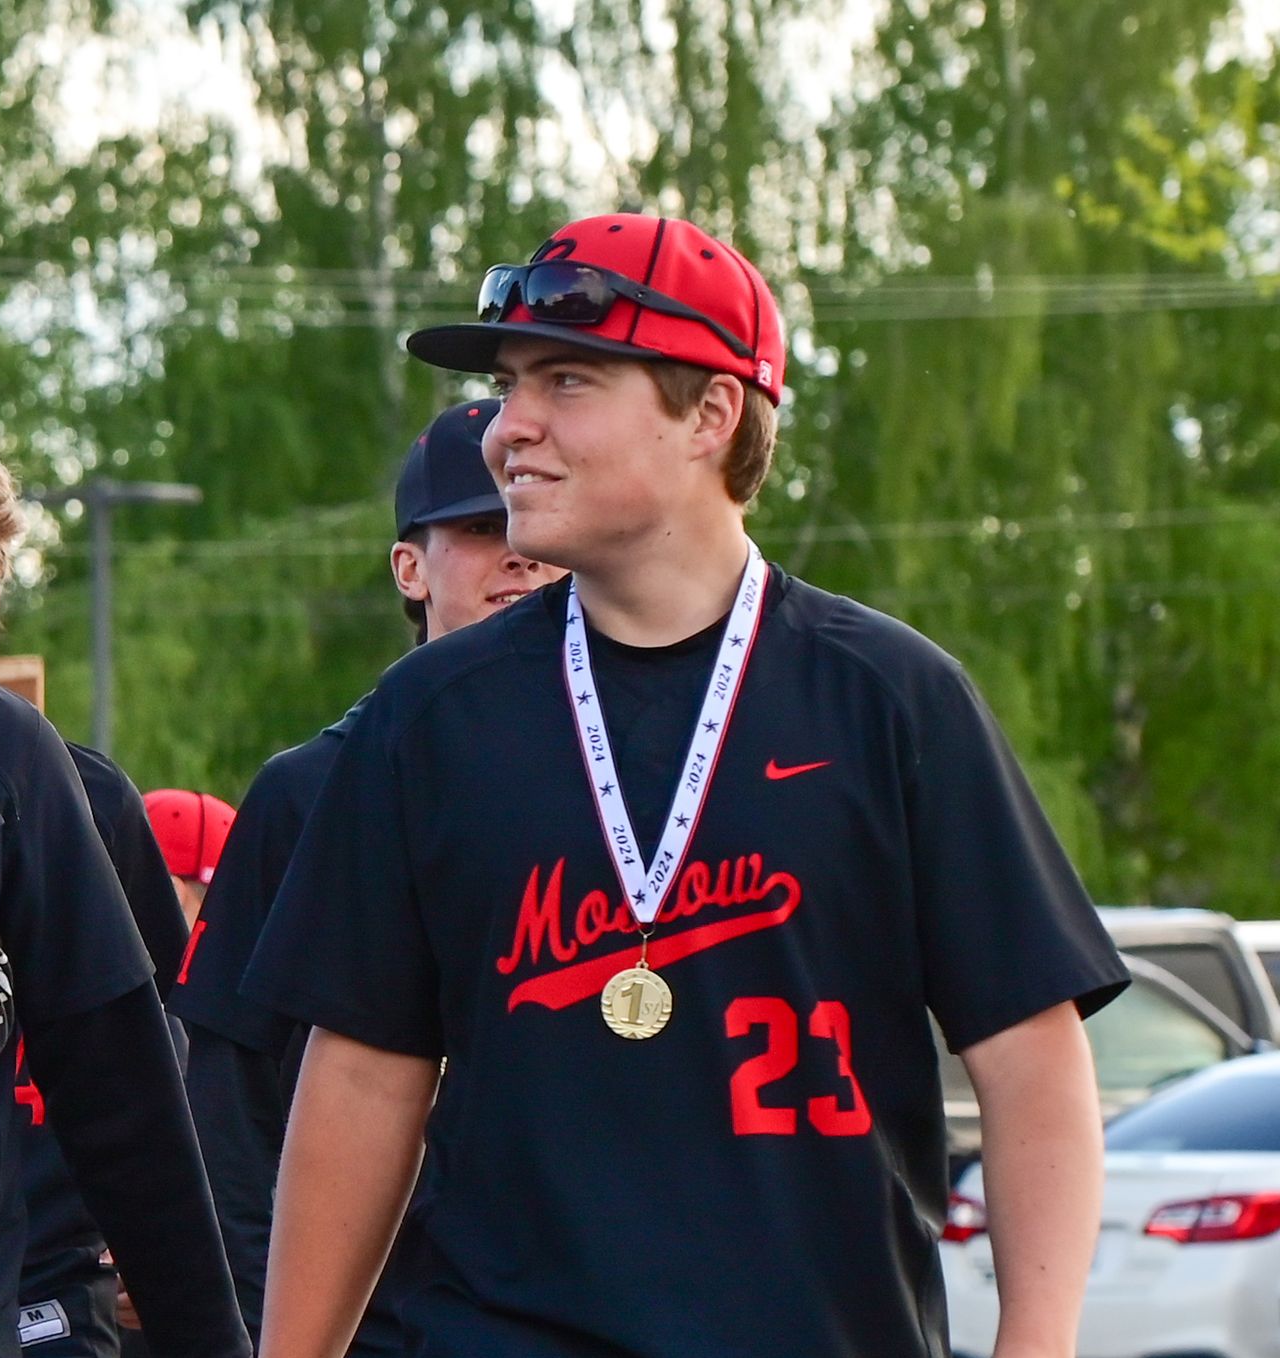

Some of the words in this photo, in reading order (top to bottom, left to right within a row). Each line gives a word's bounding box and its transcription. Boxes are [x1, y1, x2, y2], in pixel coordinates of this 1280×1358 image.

[569, 640, 584, 672] 2024
[713, 664, 734, 700] 2024
[587, 725, 606, 762] 2024
[686, 752, 707, 794] 2024
[612, 825, 635, 866] 2024
[648, 850, 675, 894] 2024
[724, 996, 873, 1137] 23
[27, 1308, 45, 1322] M
